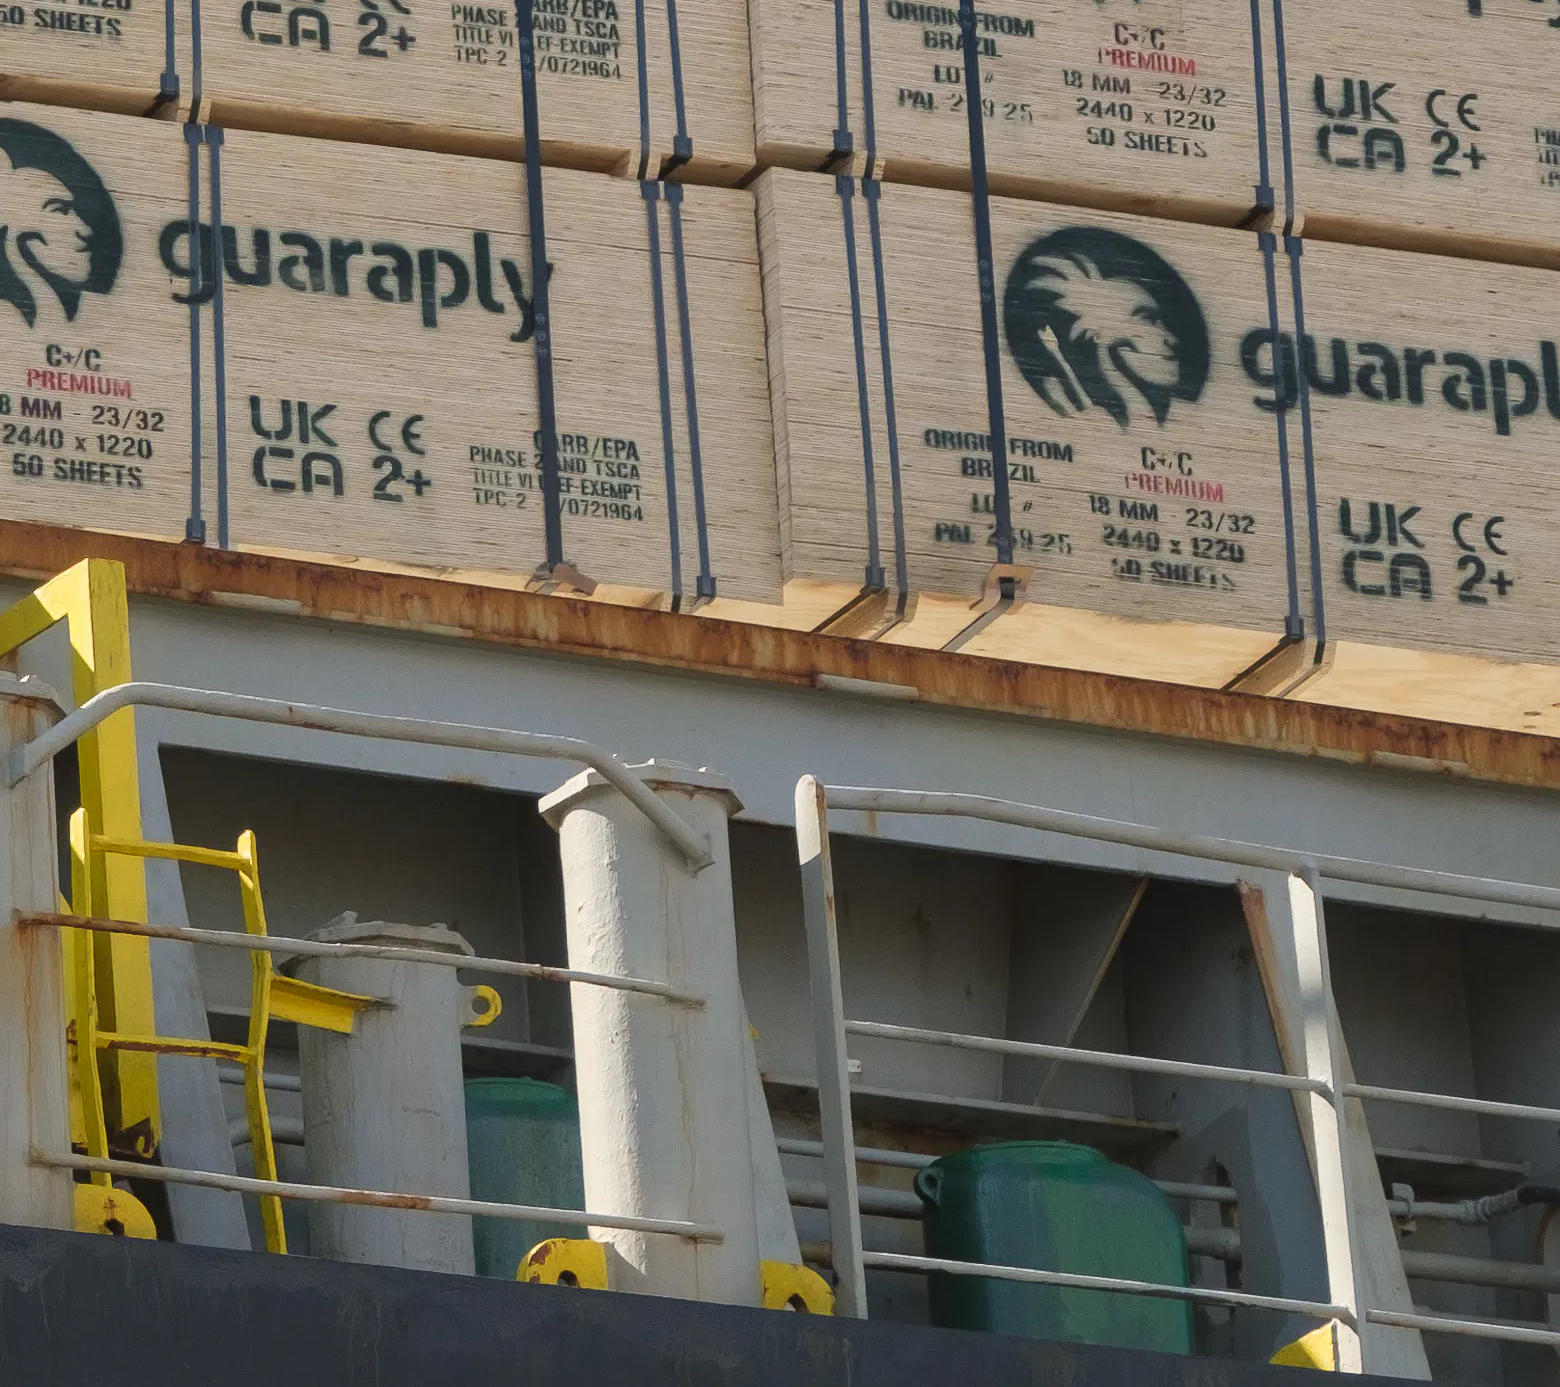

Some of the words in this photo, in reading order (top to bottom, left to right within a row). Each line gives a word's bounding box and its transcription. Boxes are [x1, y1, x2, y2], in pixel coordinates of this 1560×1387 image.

[34, 8, 122, 37] SHEETS
[240, 0, 330, 52] CA
[357, 12, 417, 58] 2+
[451, 3, 507, 25] PHASE
[453, 25, 495, 45] TITLE
[1098, 47, 1196, 76] PREMIUM
[1062, 70, 1082, 88] 18
[1092, 73, 1130, 95] MM
[1158, 81, 1227, 107] 23/32
[1314, 73, 1399, 123] UK
[1076, 98, 1132, 122] 2440
[1163, 109, 1216, 132] 1220
[1086, 127, 1115, 147] 50
[1124, 130, 1208, 158] SHEETS
[1315, 124, 1405, 173] CA
[1431, 129, 1487, 177] 2+
[157, 219, 554, 342] guaraply
[46, 343, 101, 371] C+/C
[25, 368, 133, 399] PREMIUM
[21, 396, 62, 420] MM
[91, 405, 164, 432] 23/32
[249, 395, 338, 447] UK
[2, 424, 64, 449] 2440
[97, 433, 152, 459] 1220
[1010, 438, 1074, 463] FROM
[13, 453, 43, 477] 50
[53, 457, 143, 488] SHEETS
[252, 445, 344, 495] CA
[373, 455, 432, 502] 2+
[470, 445, 527, 466] PHASE
[595, 460, 640, 480] TSCA
[473, 468, 512, 487] TITLE
[1125, 473, 1224, 503] PREMIUM
[1088, 494, 1110, 515] 18
[1119, 500, 1158, 522] MM
[1185, 507, 1256, 534] 23/32
[1339, 497, 1424, 548] UK
[1102, 525, 1160, 551] 2440
[1190, 536, 1245, 563] 1220
[1341, 550, 1433, 600] CA
[1456, 554, 1514, 605] 2+
